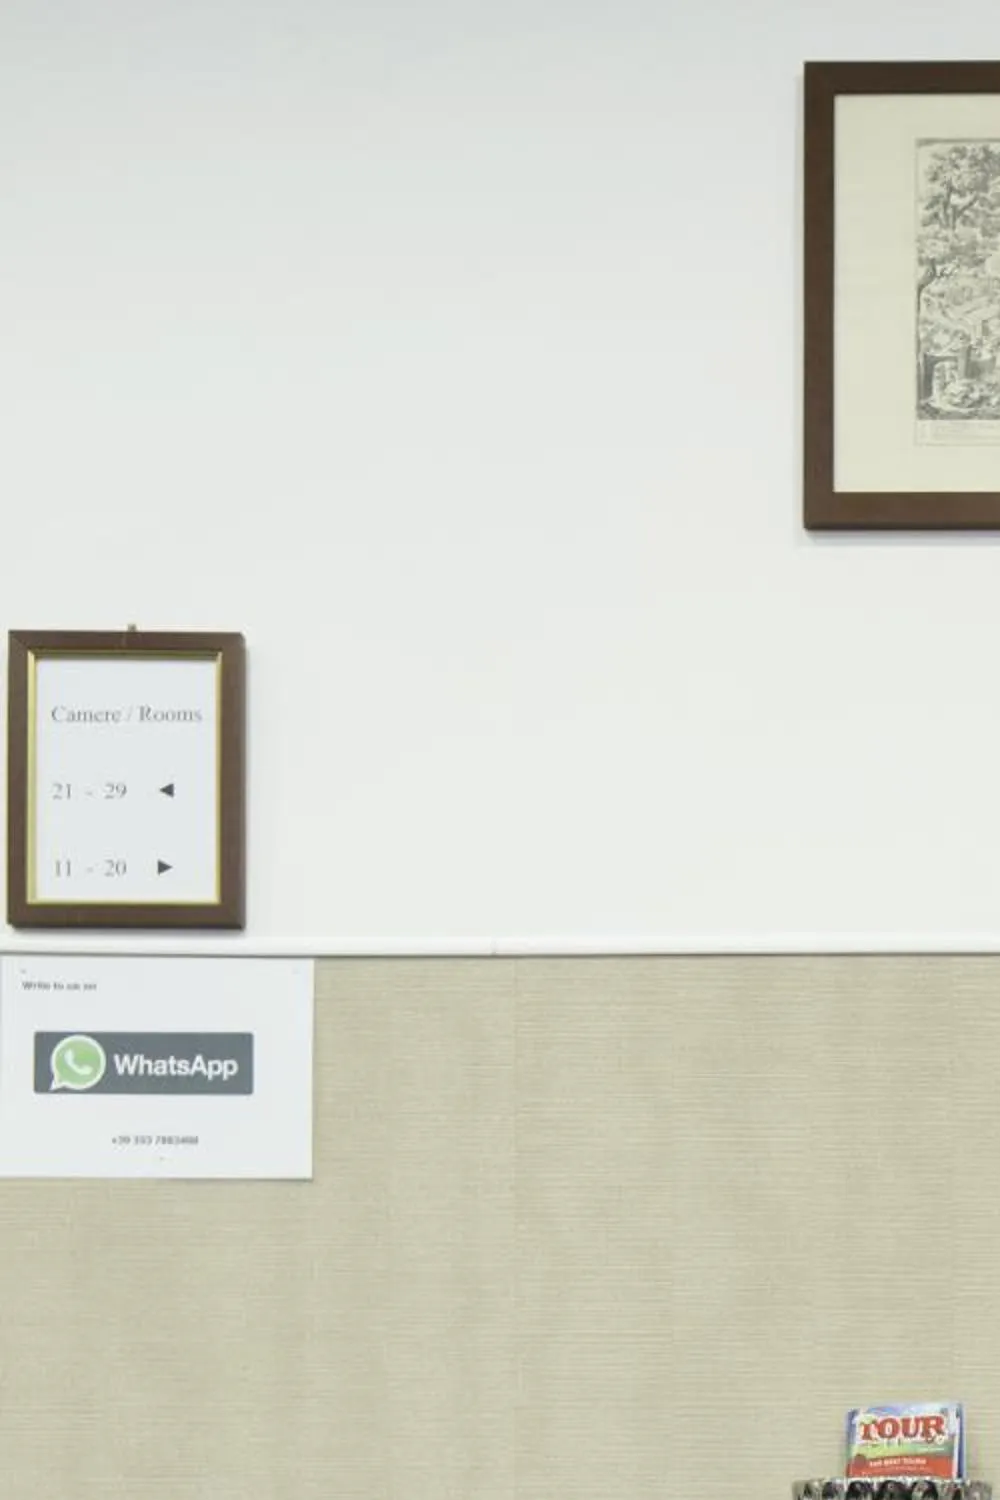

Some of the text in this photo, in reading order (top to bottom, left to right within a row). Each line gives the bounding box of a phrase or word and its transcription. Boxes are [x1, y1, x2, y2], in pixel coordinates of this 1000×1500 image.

[51, 705, 122, 723] Camere
[138, 705, 203, 723] Rooms
[52, 782, 72, 800] 21
[103, 782, 127, 800] 29
[54, 859, 72, 878] 11
[103, 859, 127, 878] 20
[113, 1053, 239, 1081] WhatsApp
[859, 1414, 946, 1440] TOUR
